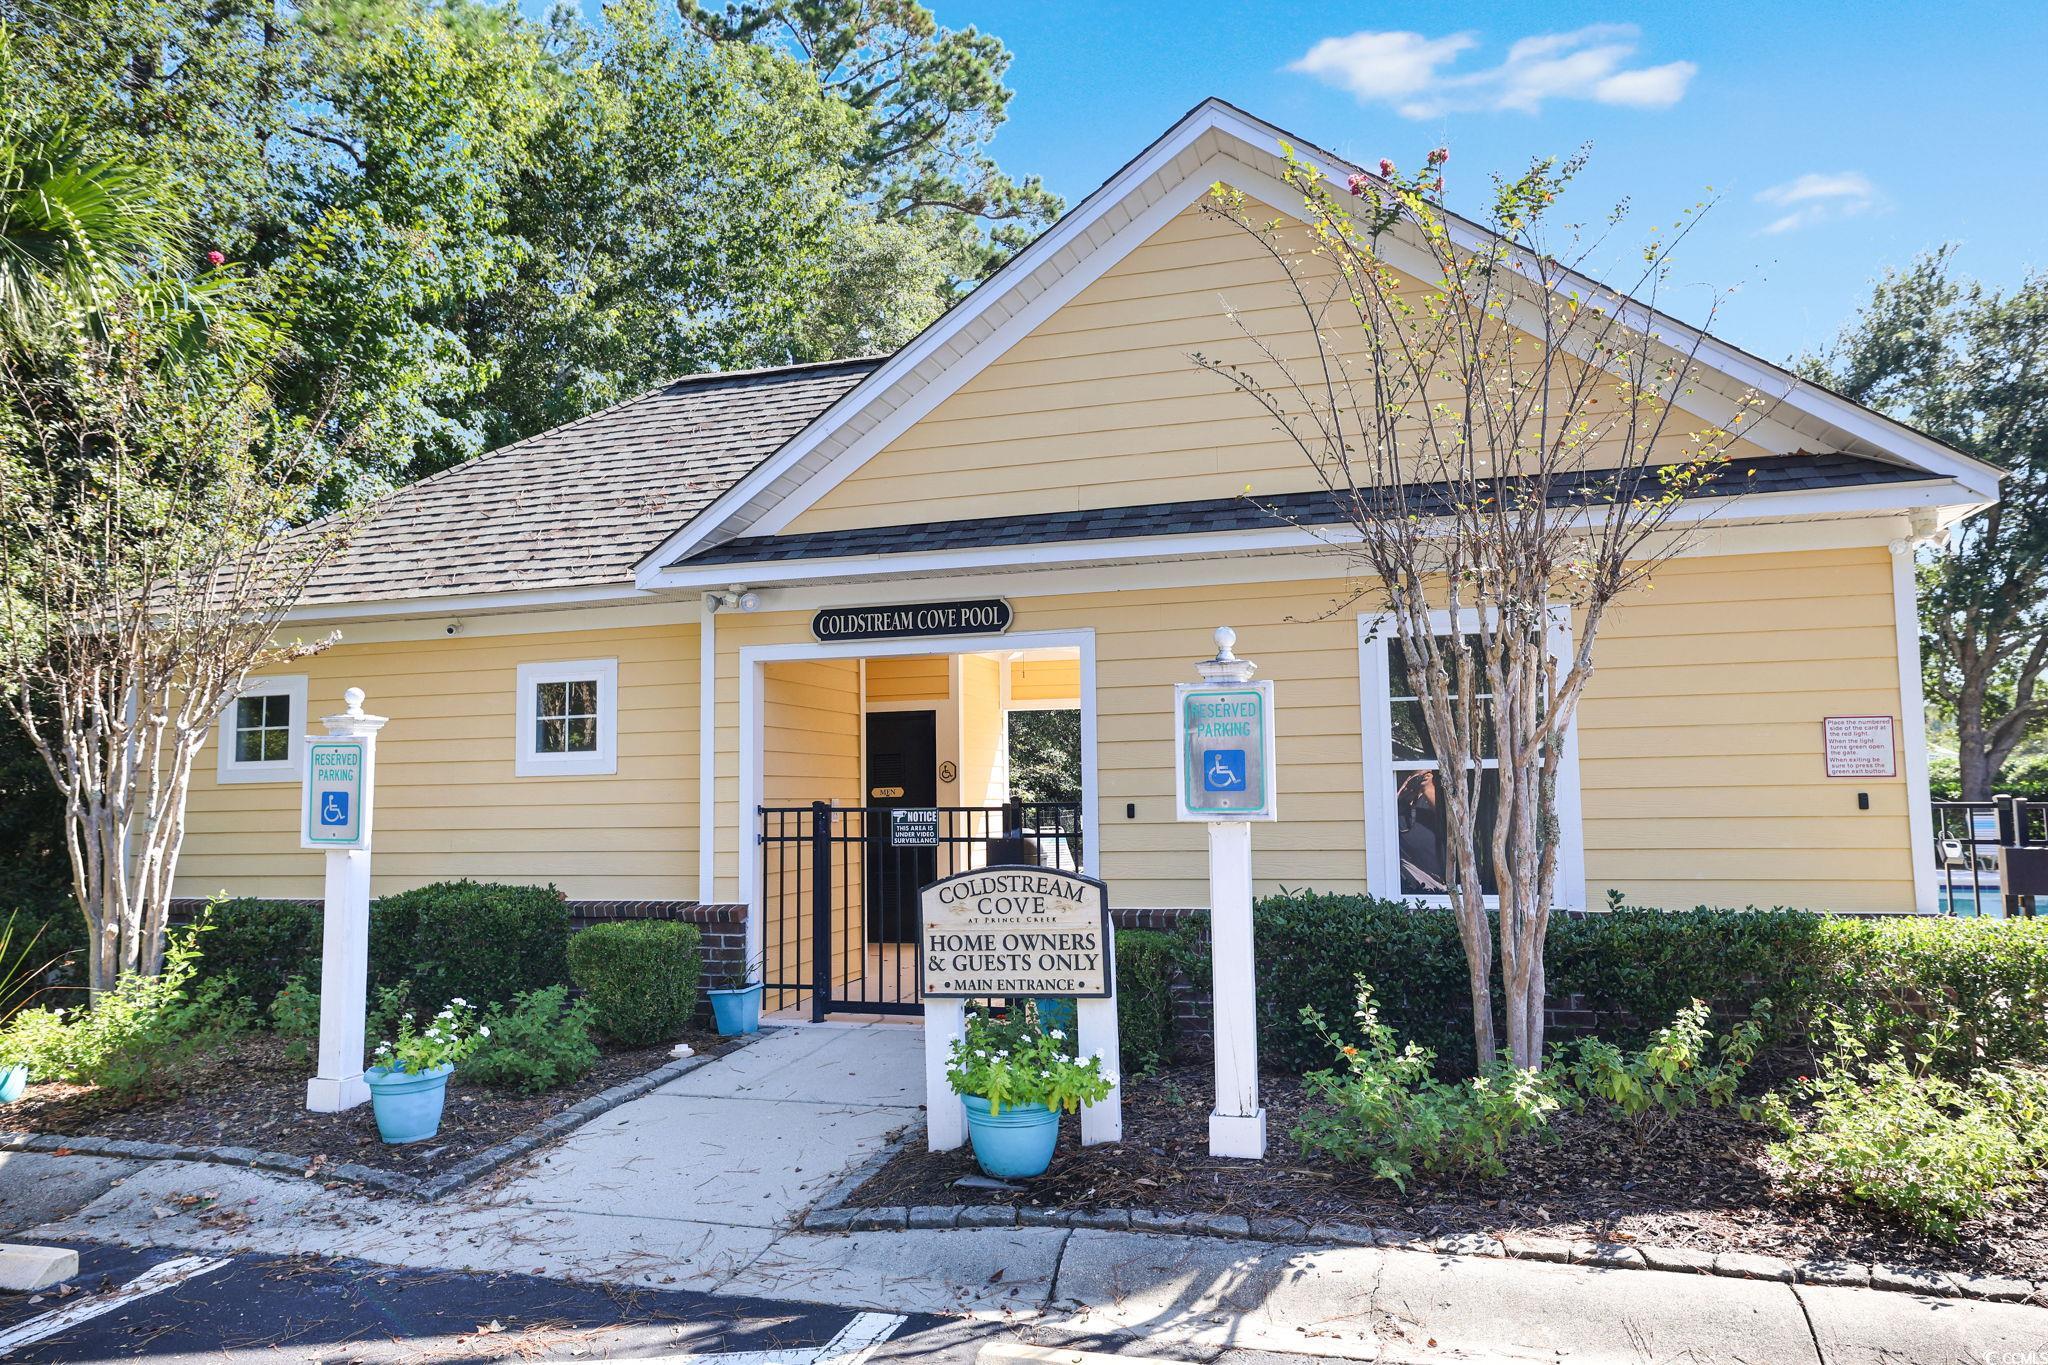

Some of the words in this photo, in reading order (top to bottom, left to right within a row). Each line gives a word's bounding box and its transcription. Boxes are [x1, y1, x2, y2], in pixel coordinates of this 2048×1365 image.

[820, 611, 913, 635] COLDSTREAM
[917, 608, 957, 629] COVE
[961, 606, 1002, 627] POOL
[1192, 702, 1256, 718] RESERVED
[1197, 722, 1251, 737] PARKING
[315, 754, 357, 765] RESERVED
[318, 770, 353, 781] PARKING
[908, 811, 936, 822] NOTICE
[939, 875, 1086, 904] COLDSTREAM
[977, 896, 1046, 915] COVE
[930, 934, 996, 952] HOME
[1002, 933, 1096, 951] OWNERS
[928, 955, 946, 972] &
[952, 954, 1032, 971] GUESTS
[1039, 953, 1099, 971] ONLY
[954, 980, 992, 991] MAIN
[997, 979, 1075, 991] ENTRANCE
